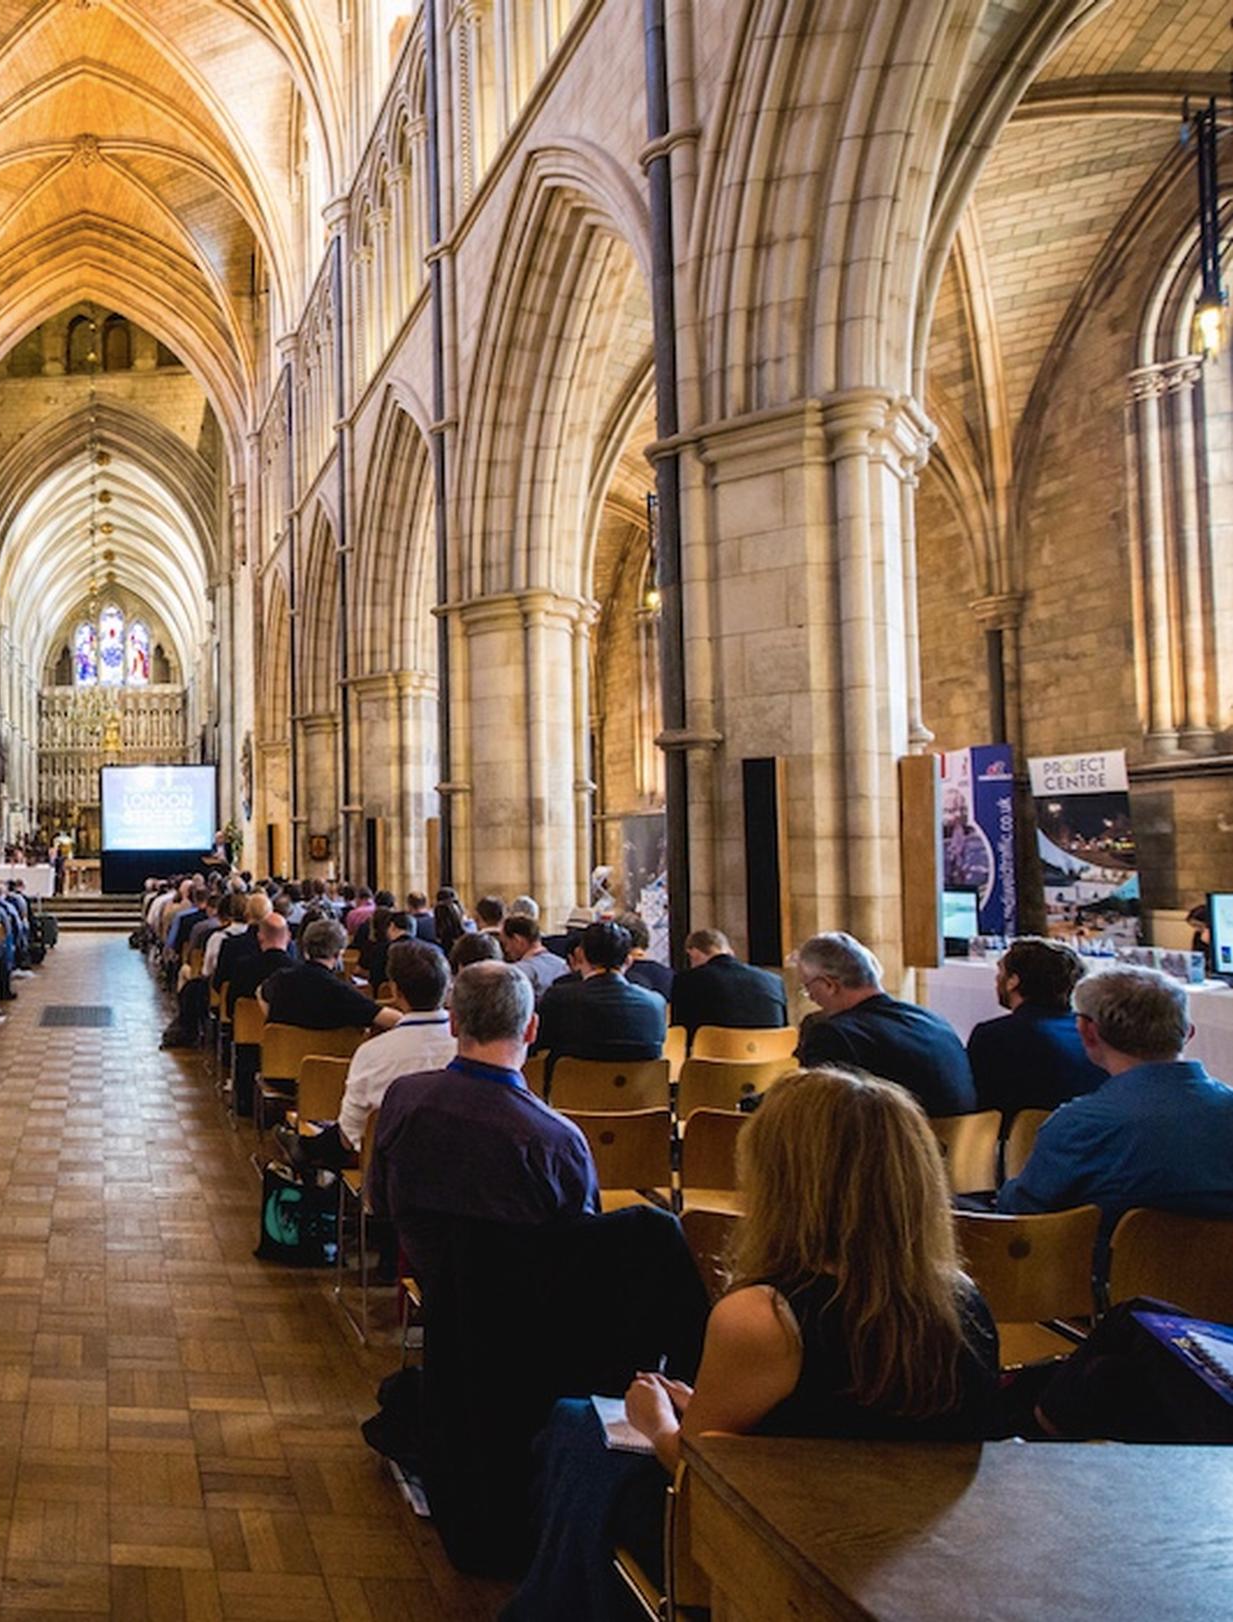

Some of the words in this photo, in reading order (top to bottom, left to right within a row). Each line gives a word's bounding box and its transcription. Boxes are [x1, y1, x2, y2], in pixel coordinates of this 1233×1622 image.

[1043, 756, 1106, 775] PROJECT
[1044, 772, 1106, 791] CENTRE
[122, 793, 193, 808] LONDON
